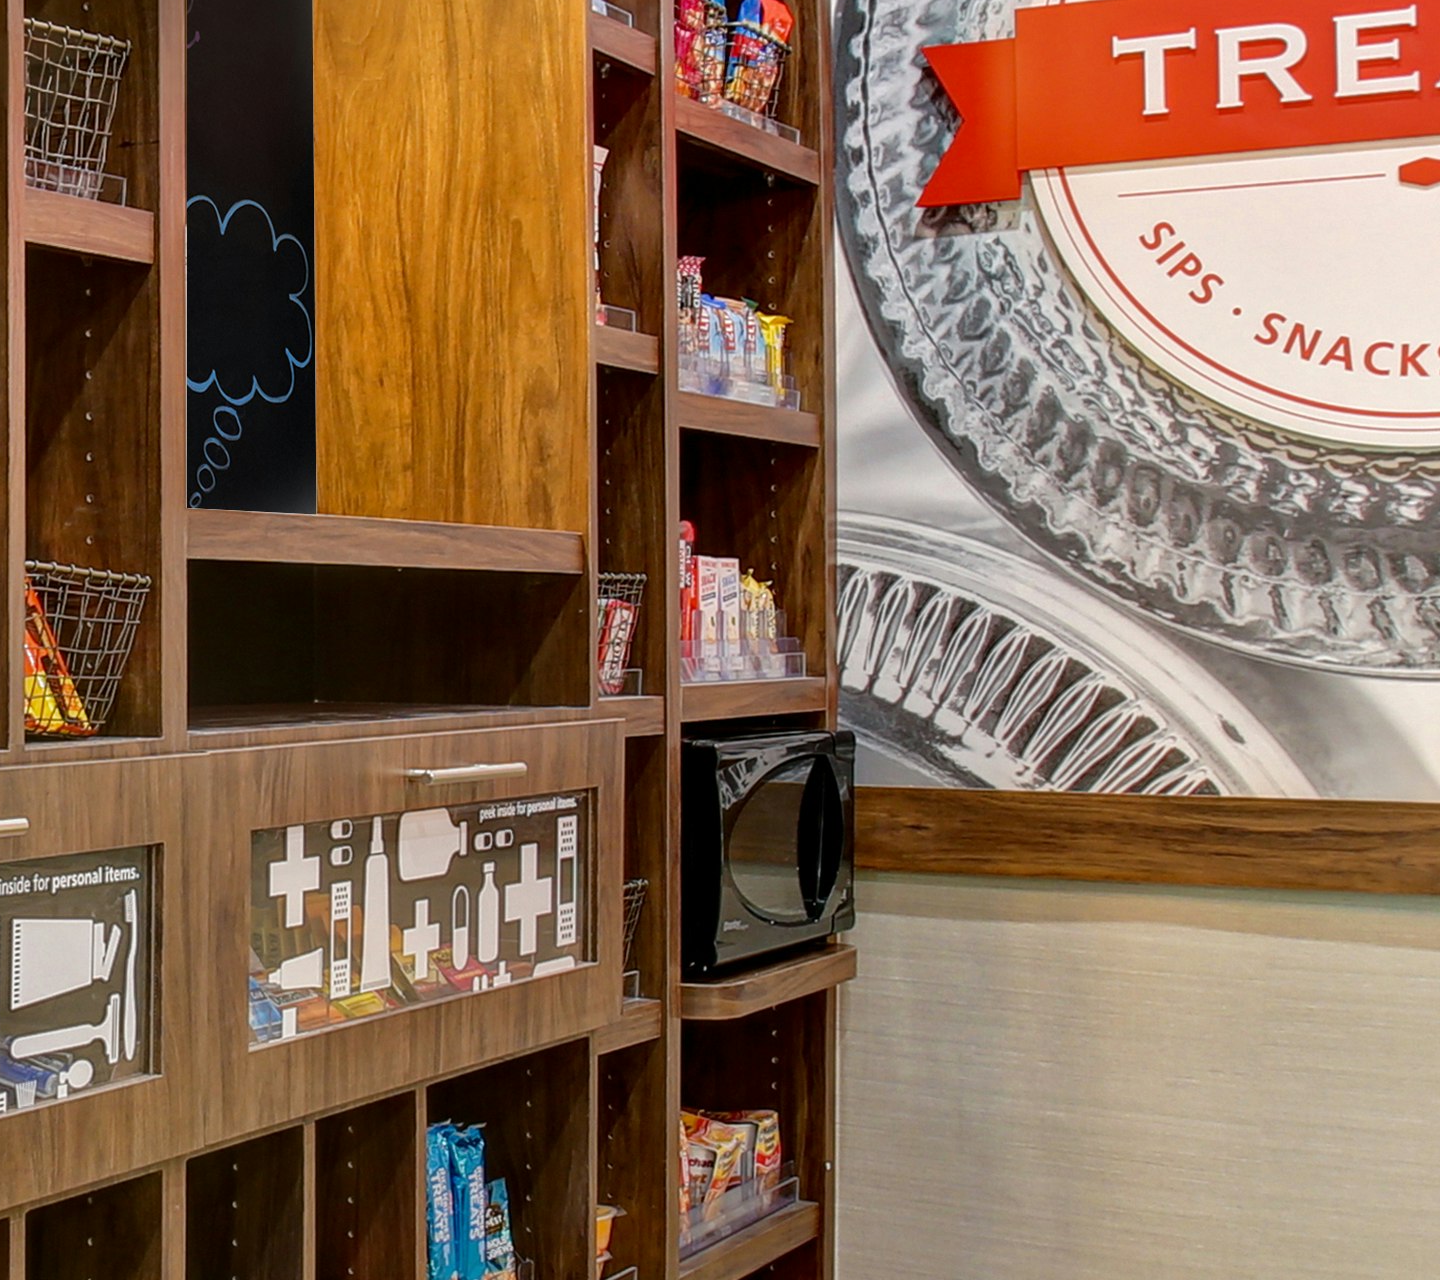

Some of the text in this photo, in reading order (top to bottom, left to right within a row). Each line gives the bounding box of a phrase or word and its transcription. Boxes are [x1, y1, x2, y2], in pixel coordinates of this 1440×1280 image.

[1138, 219, 1225, 308] SIPS
[32, 873, 51, 893] for
[51, 866, 102, 895] personal
[104, 864, 140, 883] items.
